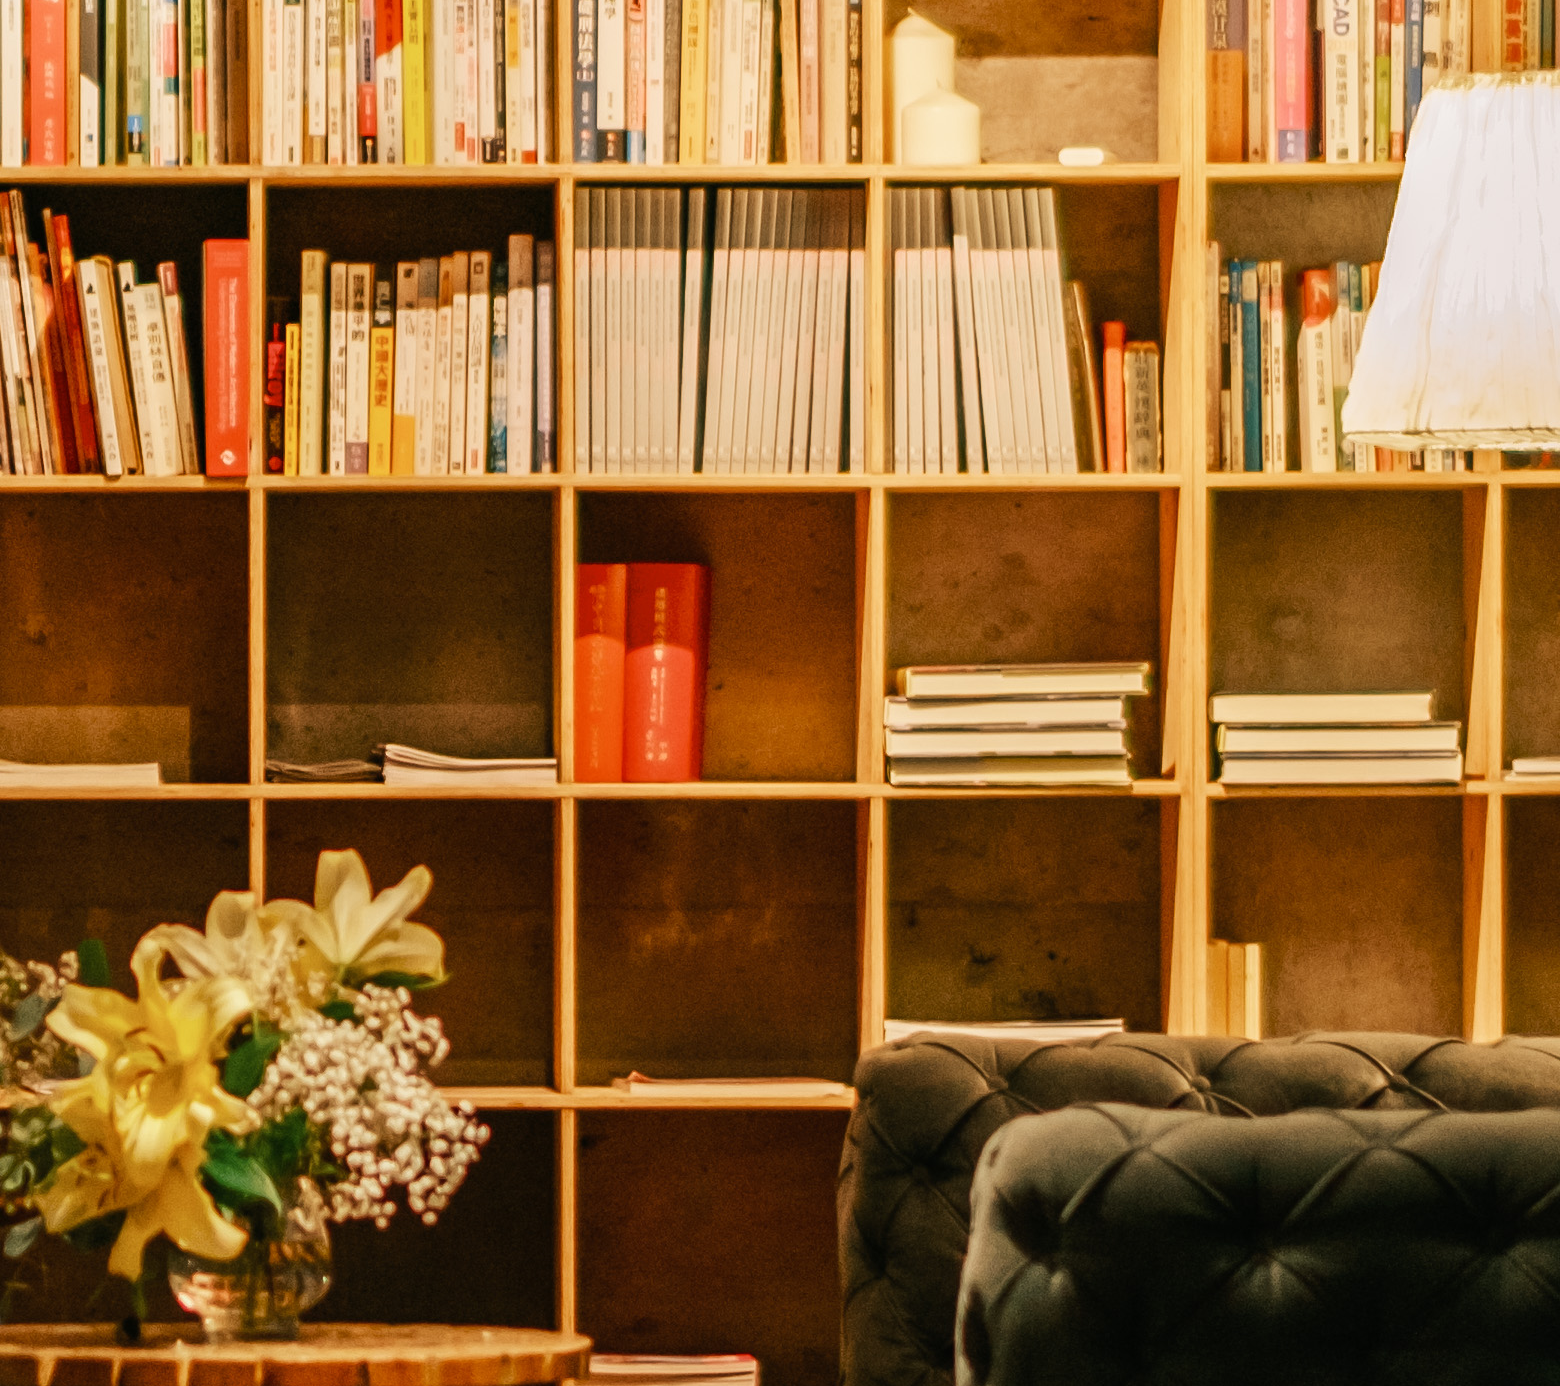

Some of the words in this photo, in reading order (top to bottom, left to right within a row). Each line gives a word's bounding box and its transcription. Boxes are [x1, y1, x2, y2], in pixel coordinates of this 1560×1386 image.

[373, 334, 389, 407] 中國大歷史
